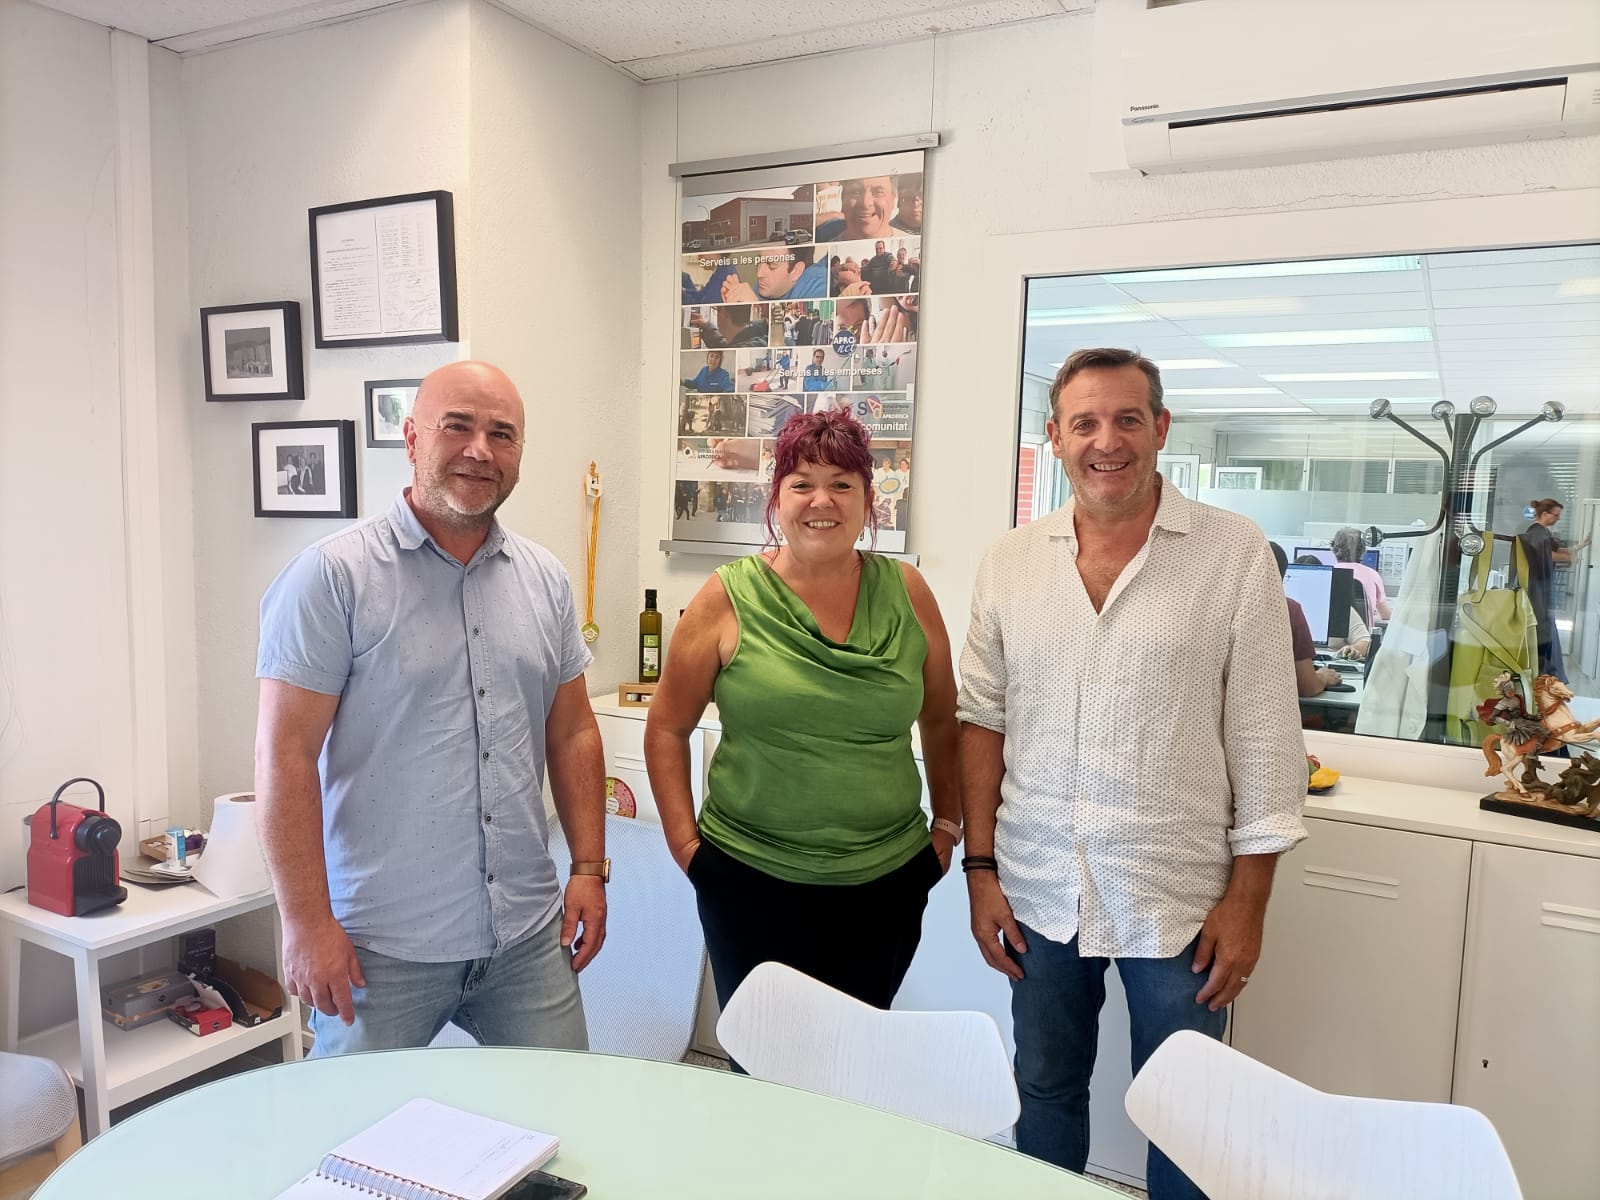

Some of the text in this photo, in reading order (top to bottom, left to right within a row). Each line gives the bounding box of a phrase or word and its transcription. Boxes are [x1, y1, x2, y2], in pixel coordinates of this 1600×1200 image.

[699, 253, 796, 267] Serveis a les persones
[833, 336, 855, 344] APRO
[779, 368, 812, 377] Serveis
[822, 368, 835, 376] les
[837, 367, 883, 378] empreses
[862, 422, 909, 431] comunitat
